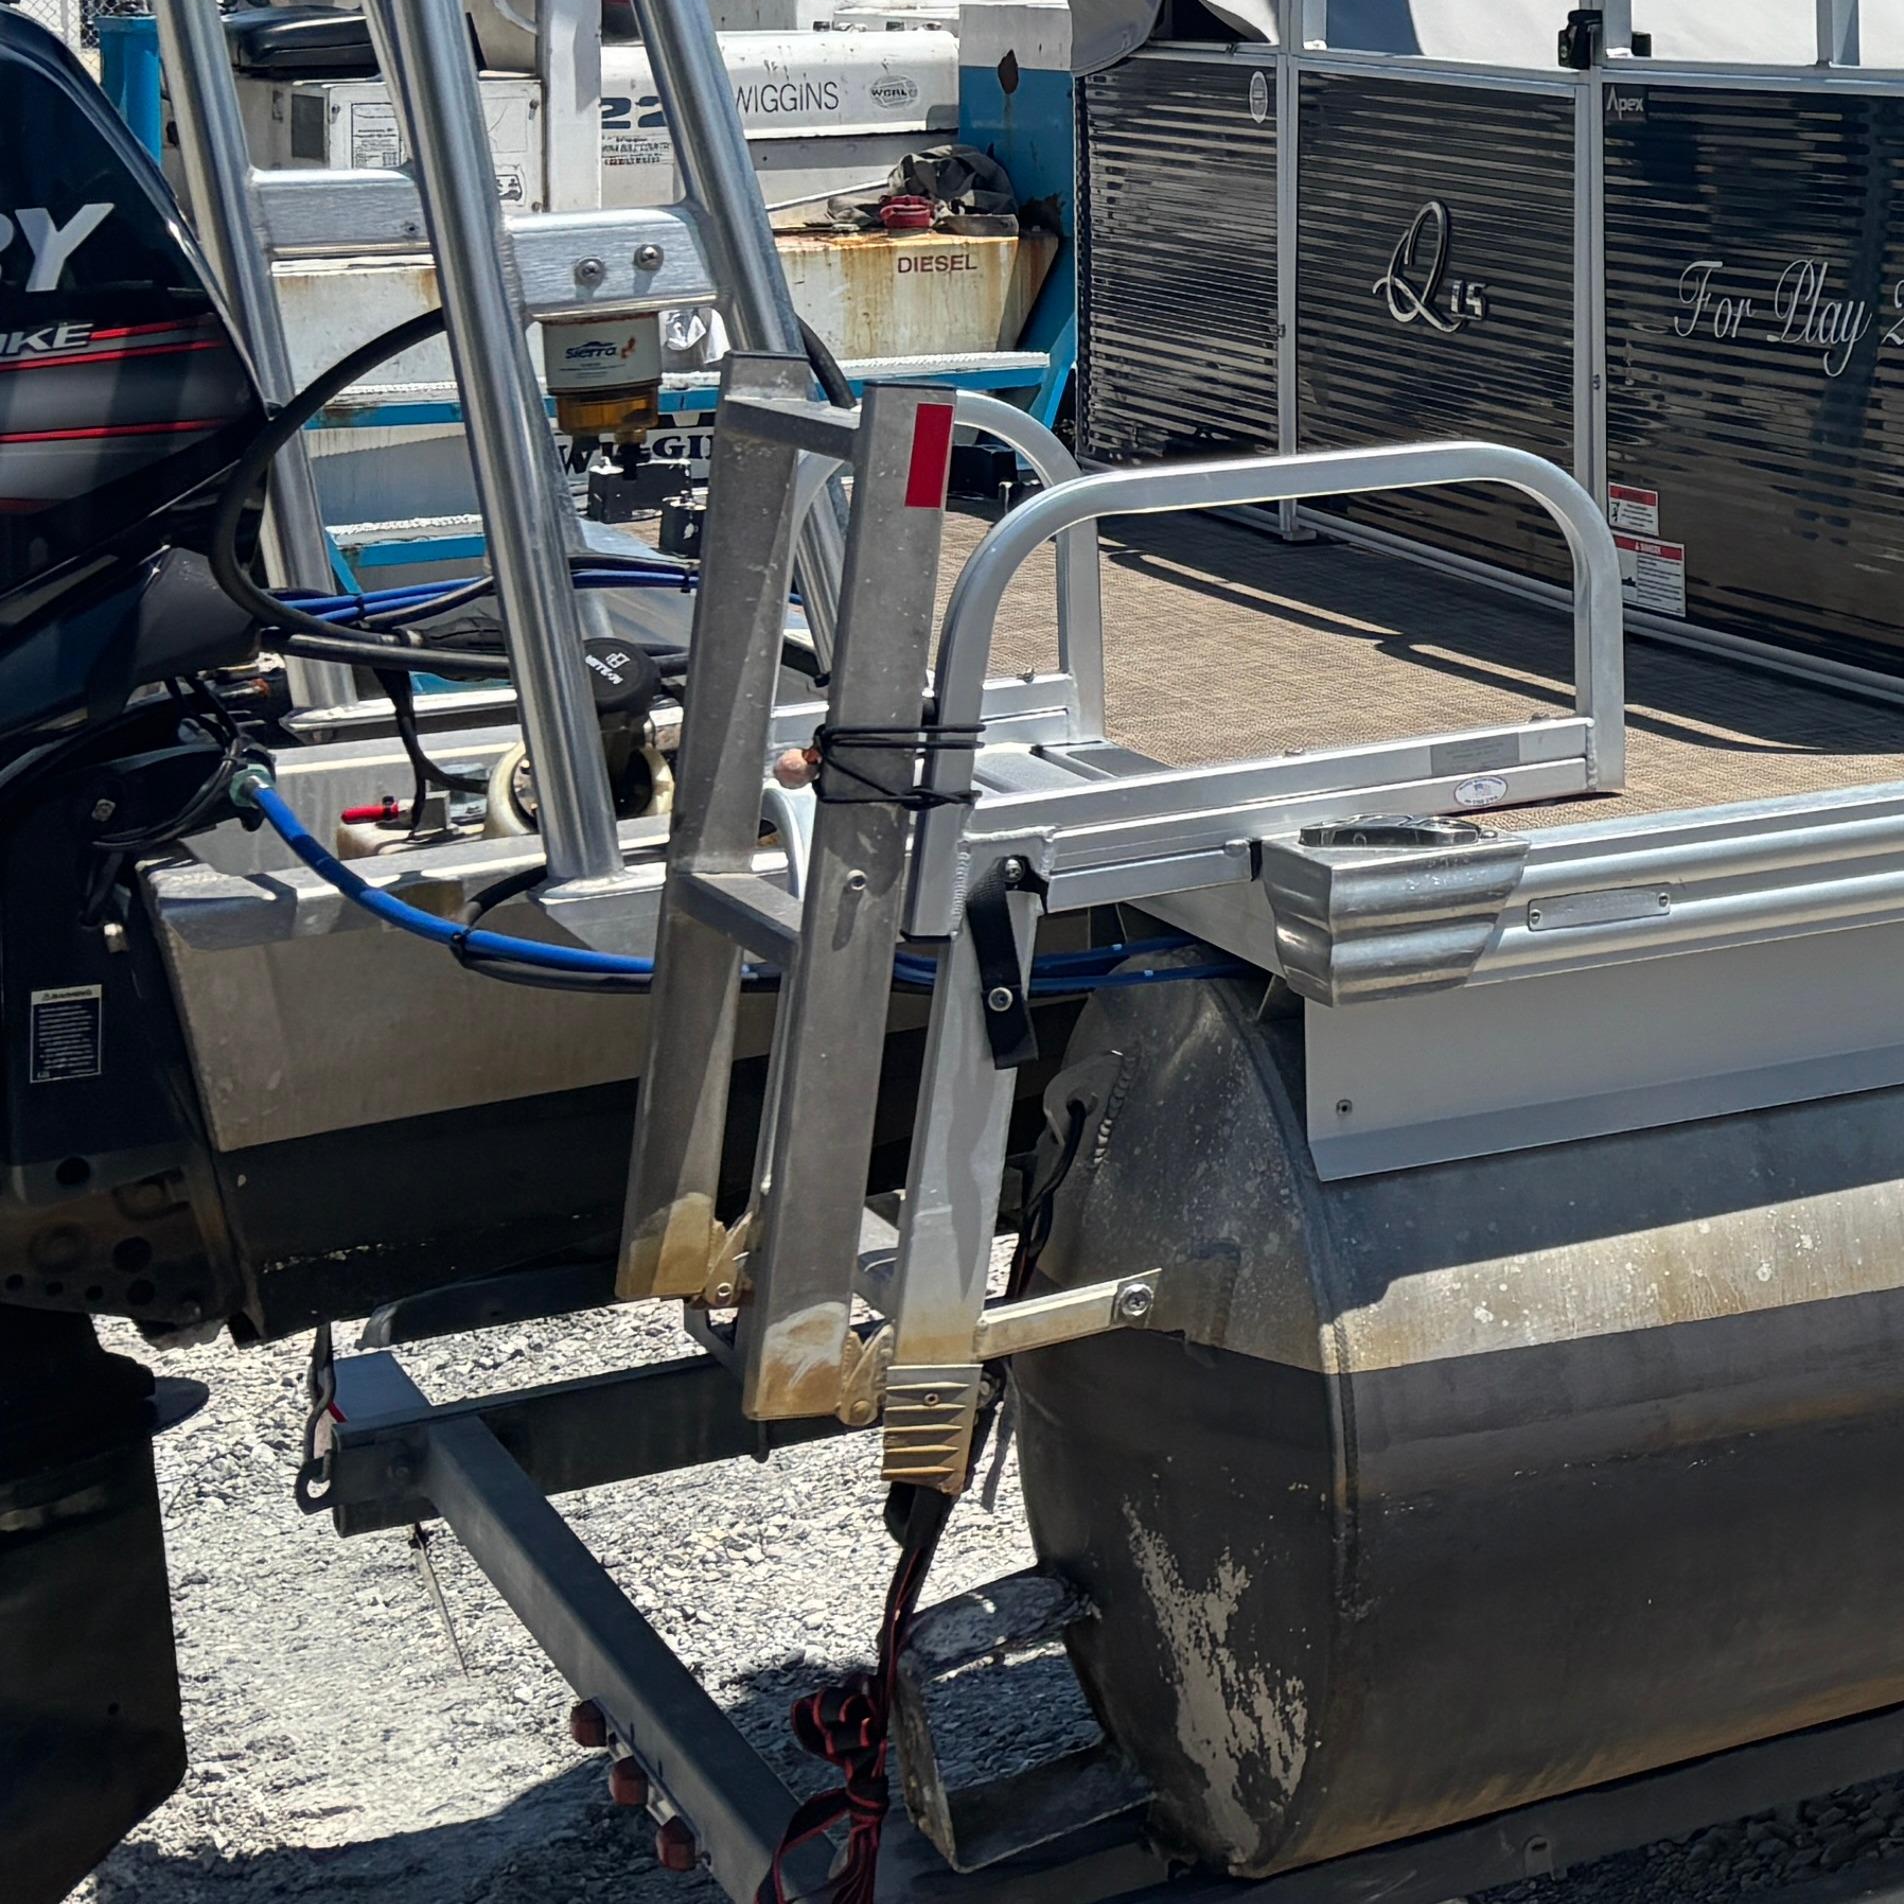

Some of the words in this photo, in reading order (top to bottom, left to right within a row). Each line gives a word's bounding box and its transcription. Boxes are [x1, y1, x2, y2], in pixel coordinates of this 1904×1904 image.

[736, 80, 840, 114] WIGGINS
[1606, 86, 1644, 121] Apex
[0, 202, 115, 293] Y
[897, 254, 979, 274] DIESEL
[1674, 260, 1756, 338] For
[1766, 258, 1873, 377] Play
[565, 344, 617, 360] Sierra
